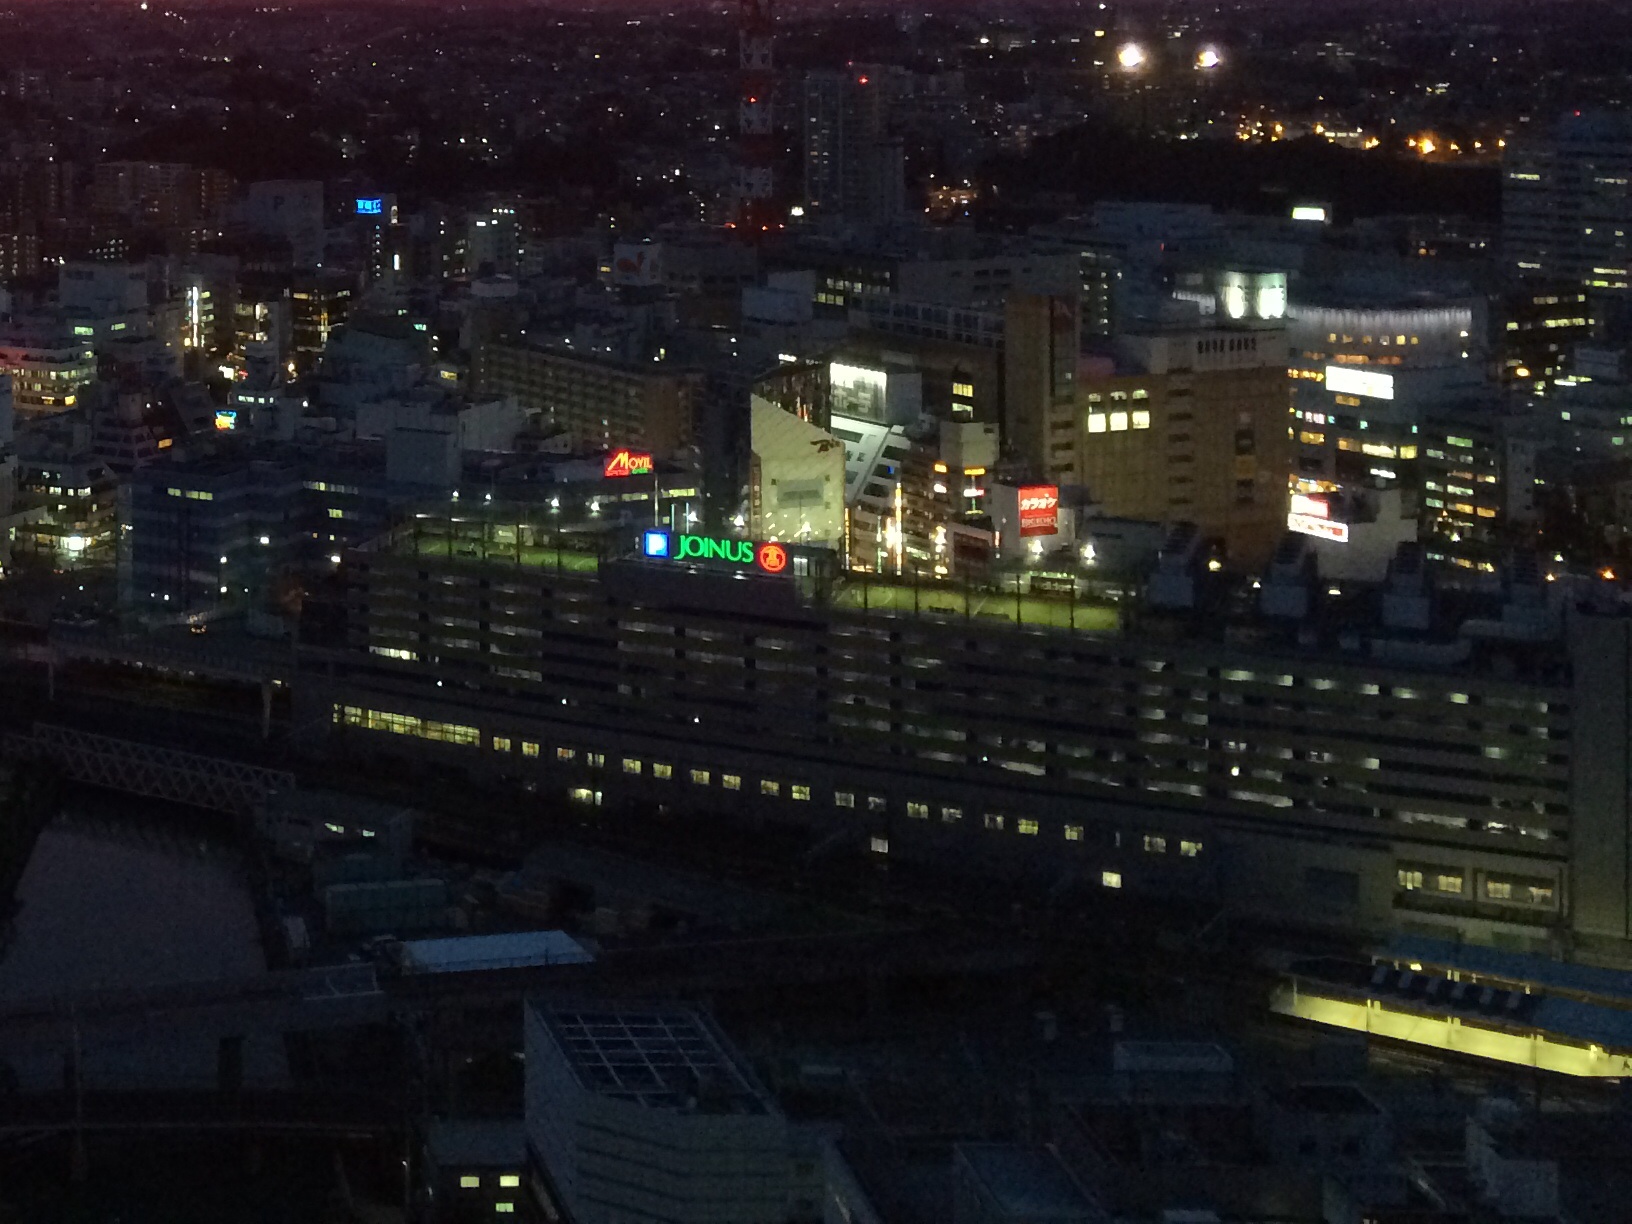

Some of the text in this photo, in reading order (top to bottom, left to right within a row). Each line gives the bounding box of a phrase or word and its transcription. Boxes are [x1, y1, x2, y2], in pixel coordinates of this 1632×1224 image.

[1020, 493, 1058, 510] カラオケ
[648, 533, 666, 555] P
[674, 534, 754, 563] JOINUS
